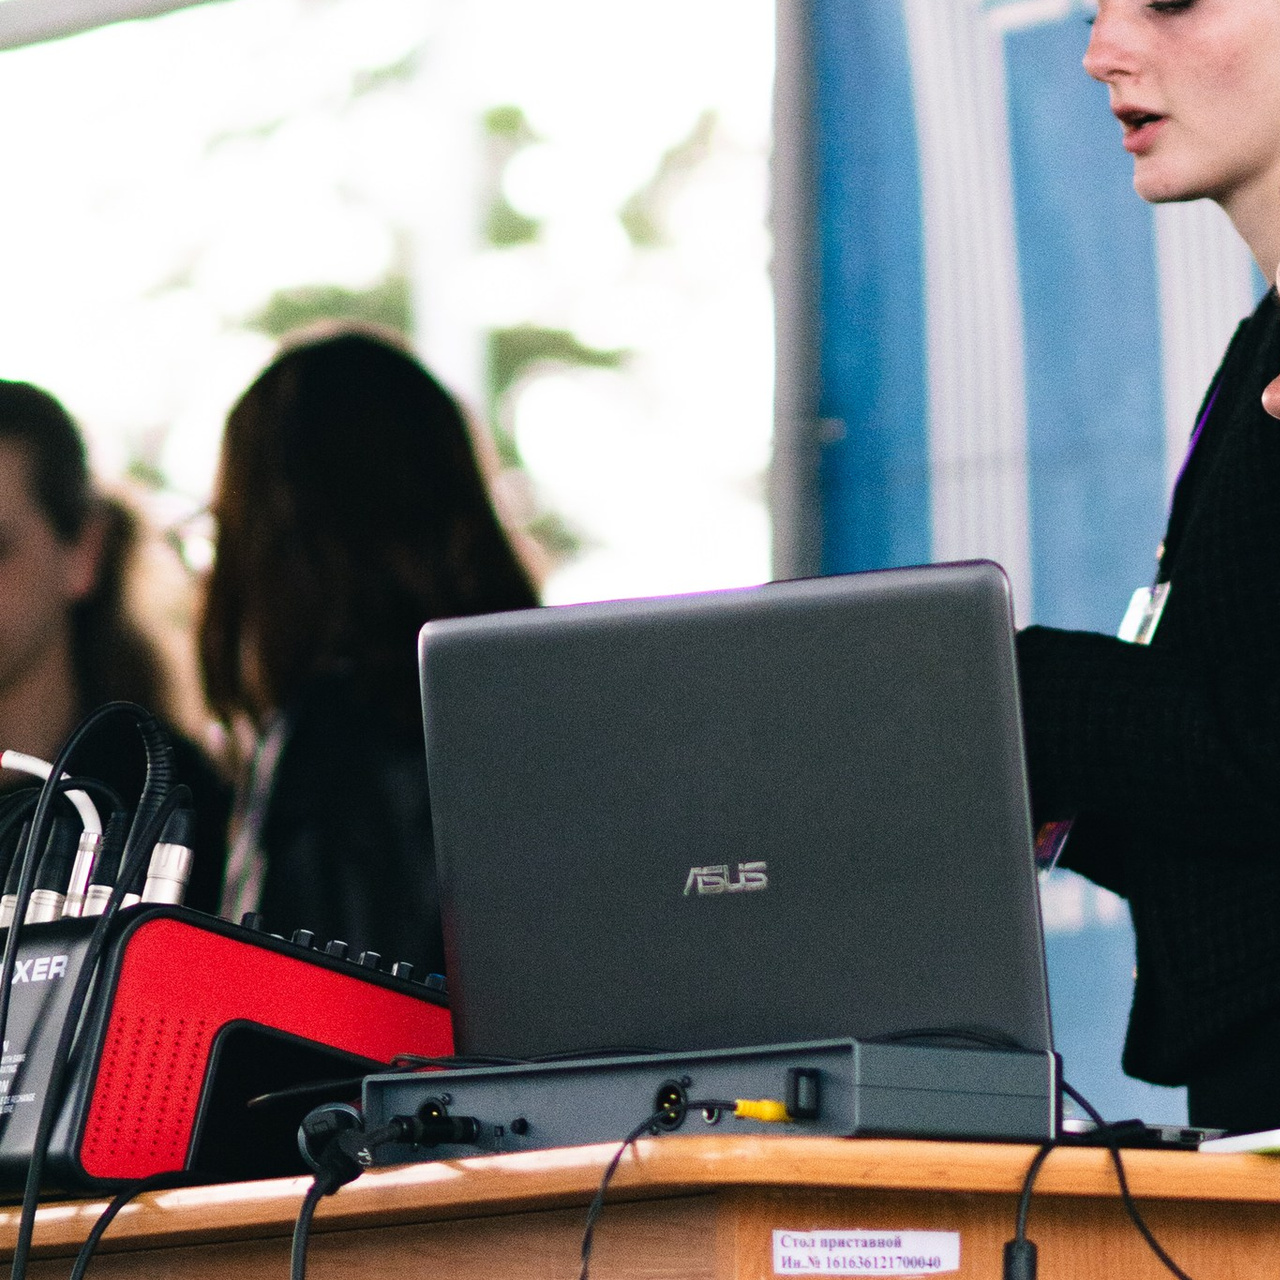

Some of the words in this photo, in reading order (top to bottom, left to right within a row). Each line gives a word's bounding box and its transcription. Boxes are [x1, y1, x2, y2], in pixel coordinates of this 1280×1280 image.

[682, 860, 769, 897] ASUS
[780, 1234, 815, 1248] Стол
[820, 1235, 902, 1251] приставной
